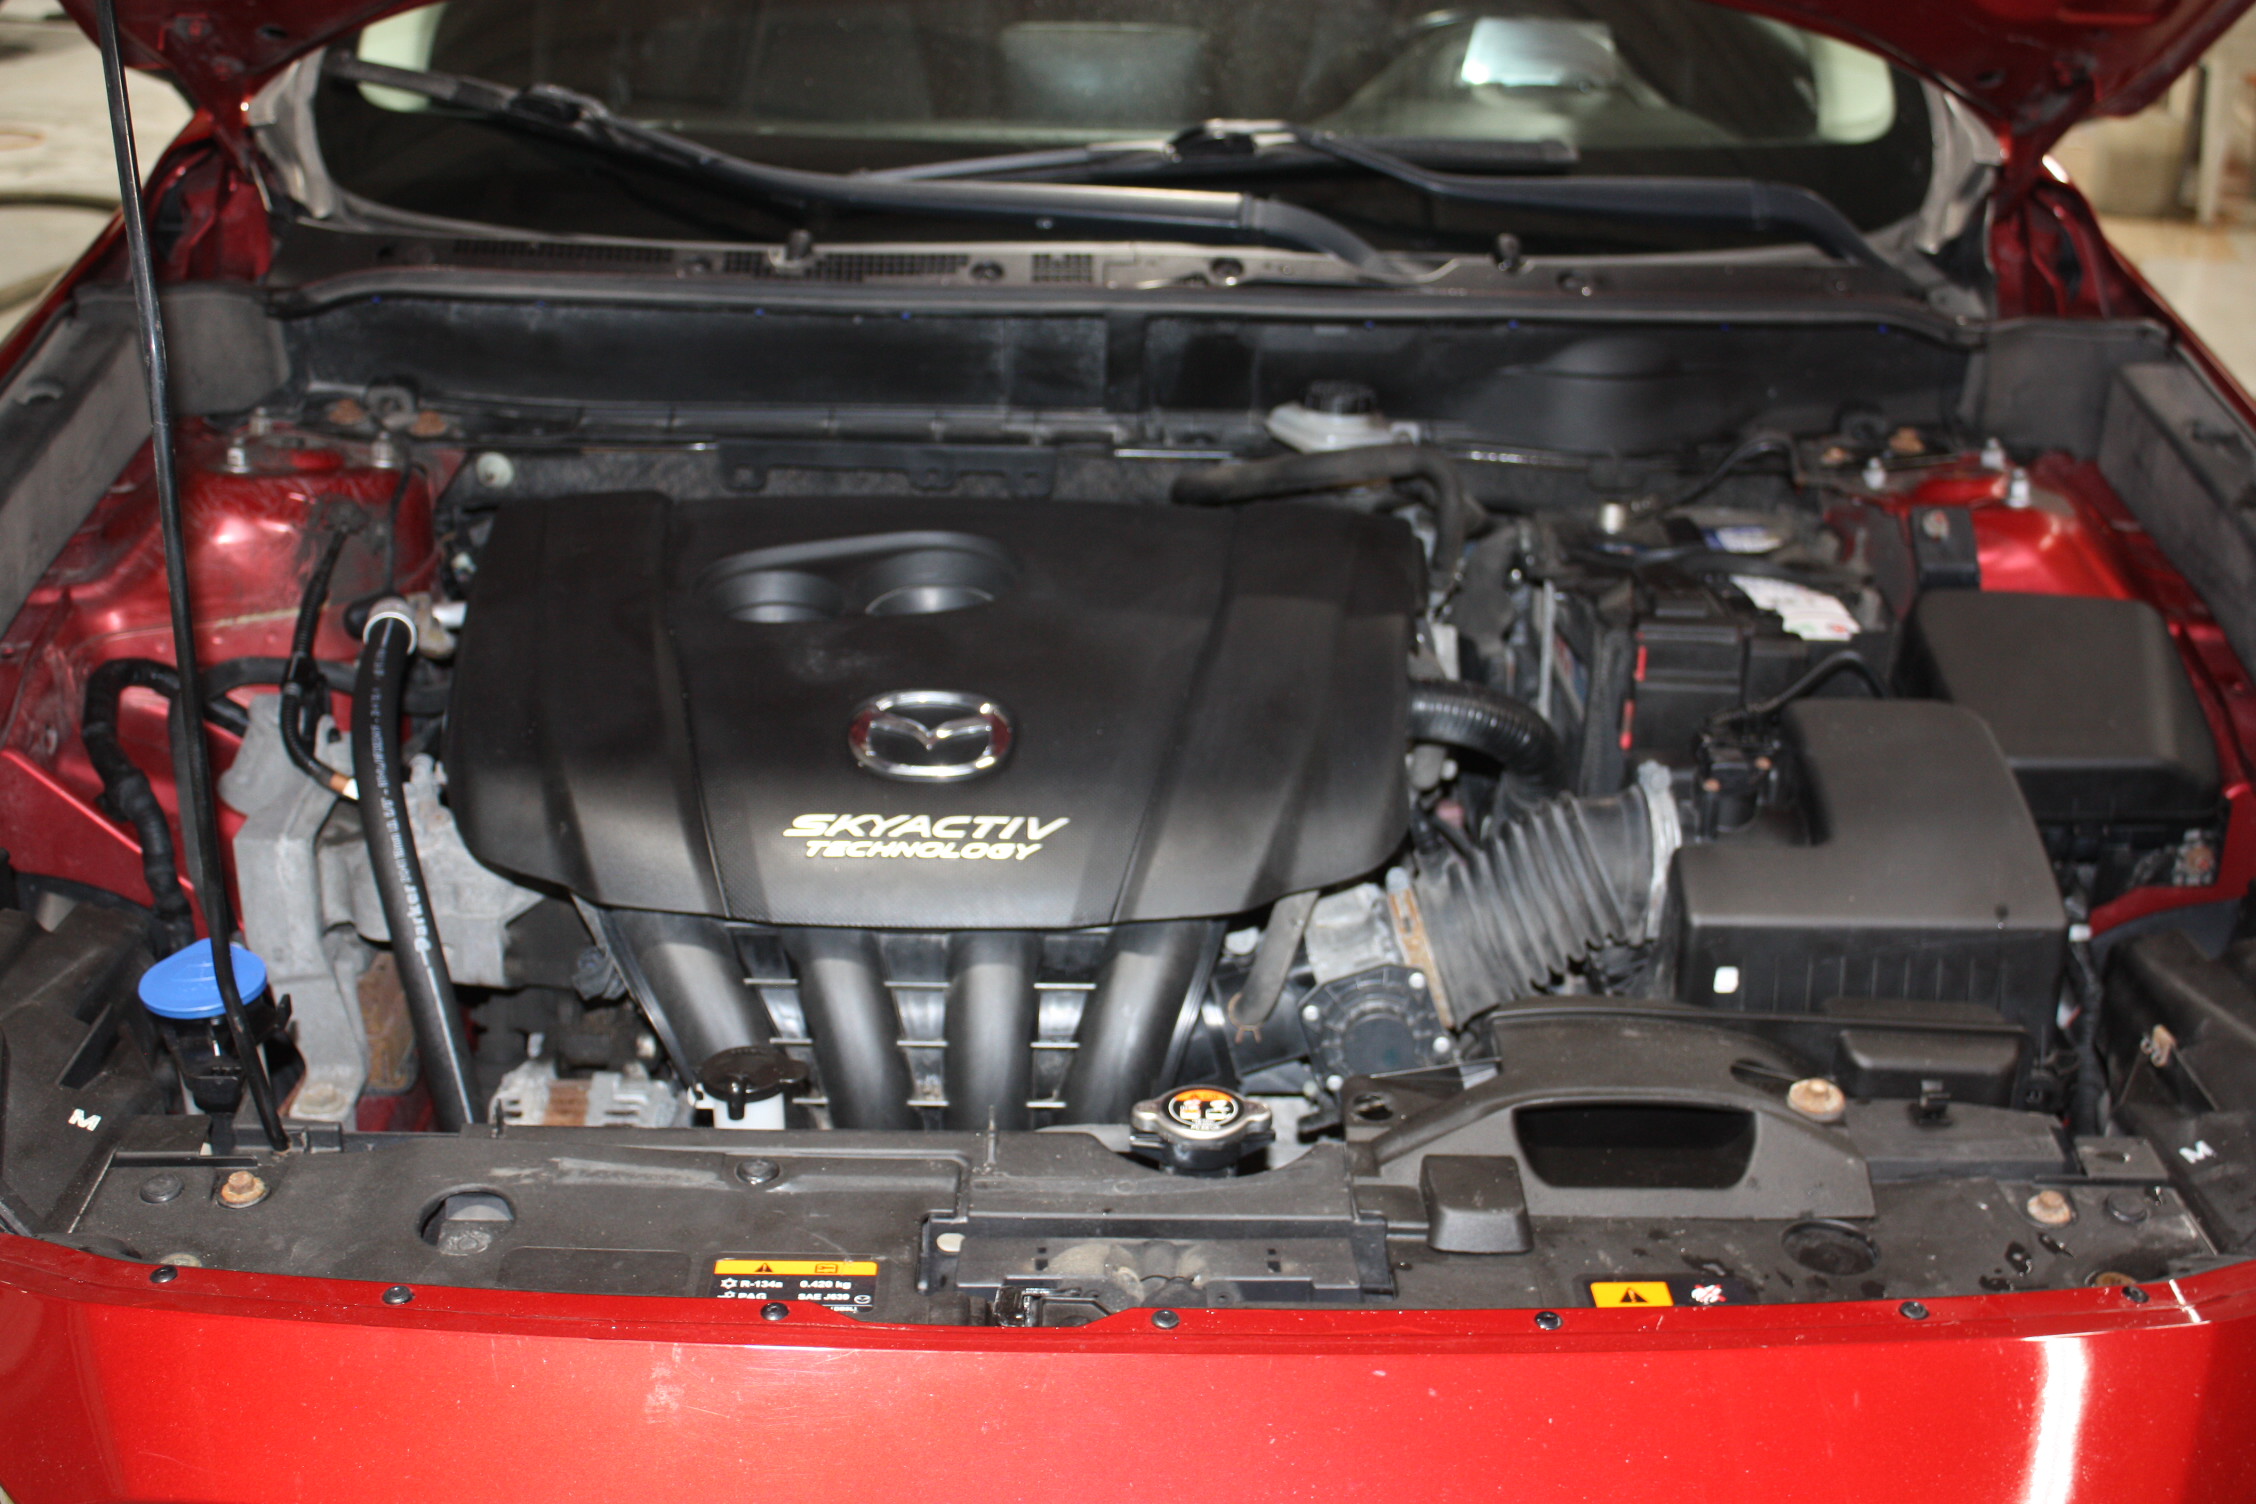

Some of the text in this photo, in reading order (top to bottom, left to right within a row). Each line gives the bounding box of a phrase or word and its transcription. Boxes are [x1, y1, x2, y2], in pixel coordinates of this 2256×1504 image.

[783, 814, 1070, 840] SKYACTIV
[806, 840, 1043, 860] TECHNOLOGY
[404, 885, 432, 952] Parker
[740, 1279, 783, 1288] R-134a
[835, 1280, 851, 1290] kg
[737, 1292, 767, 1300] PAG
[797, 1292, 822, 1301] SAE
